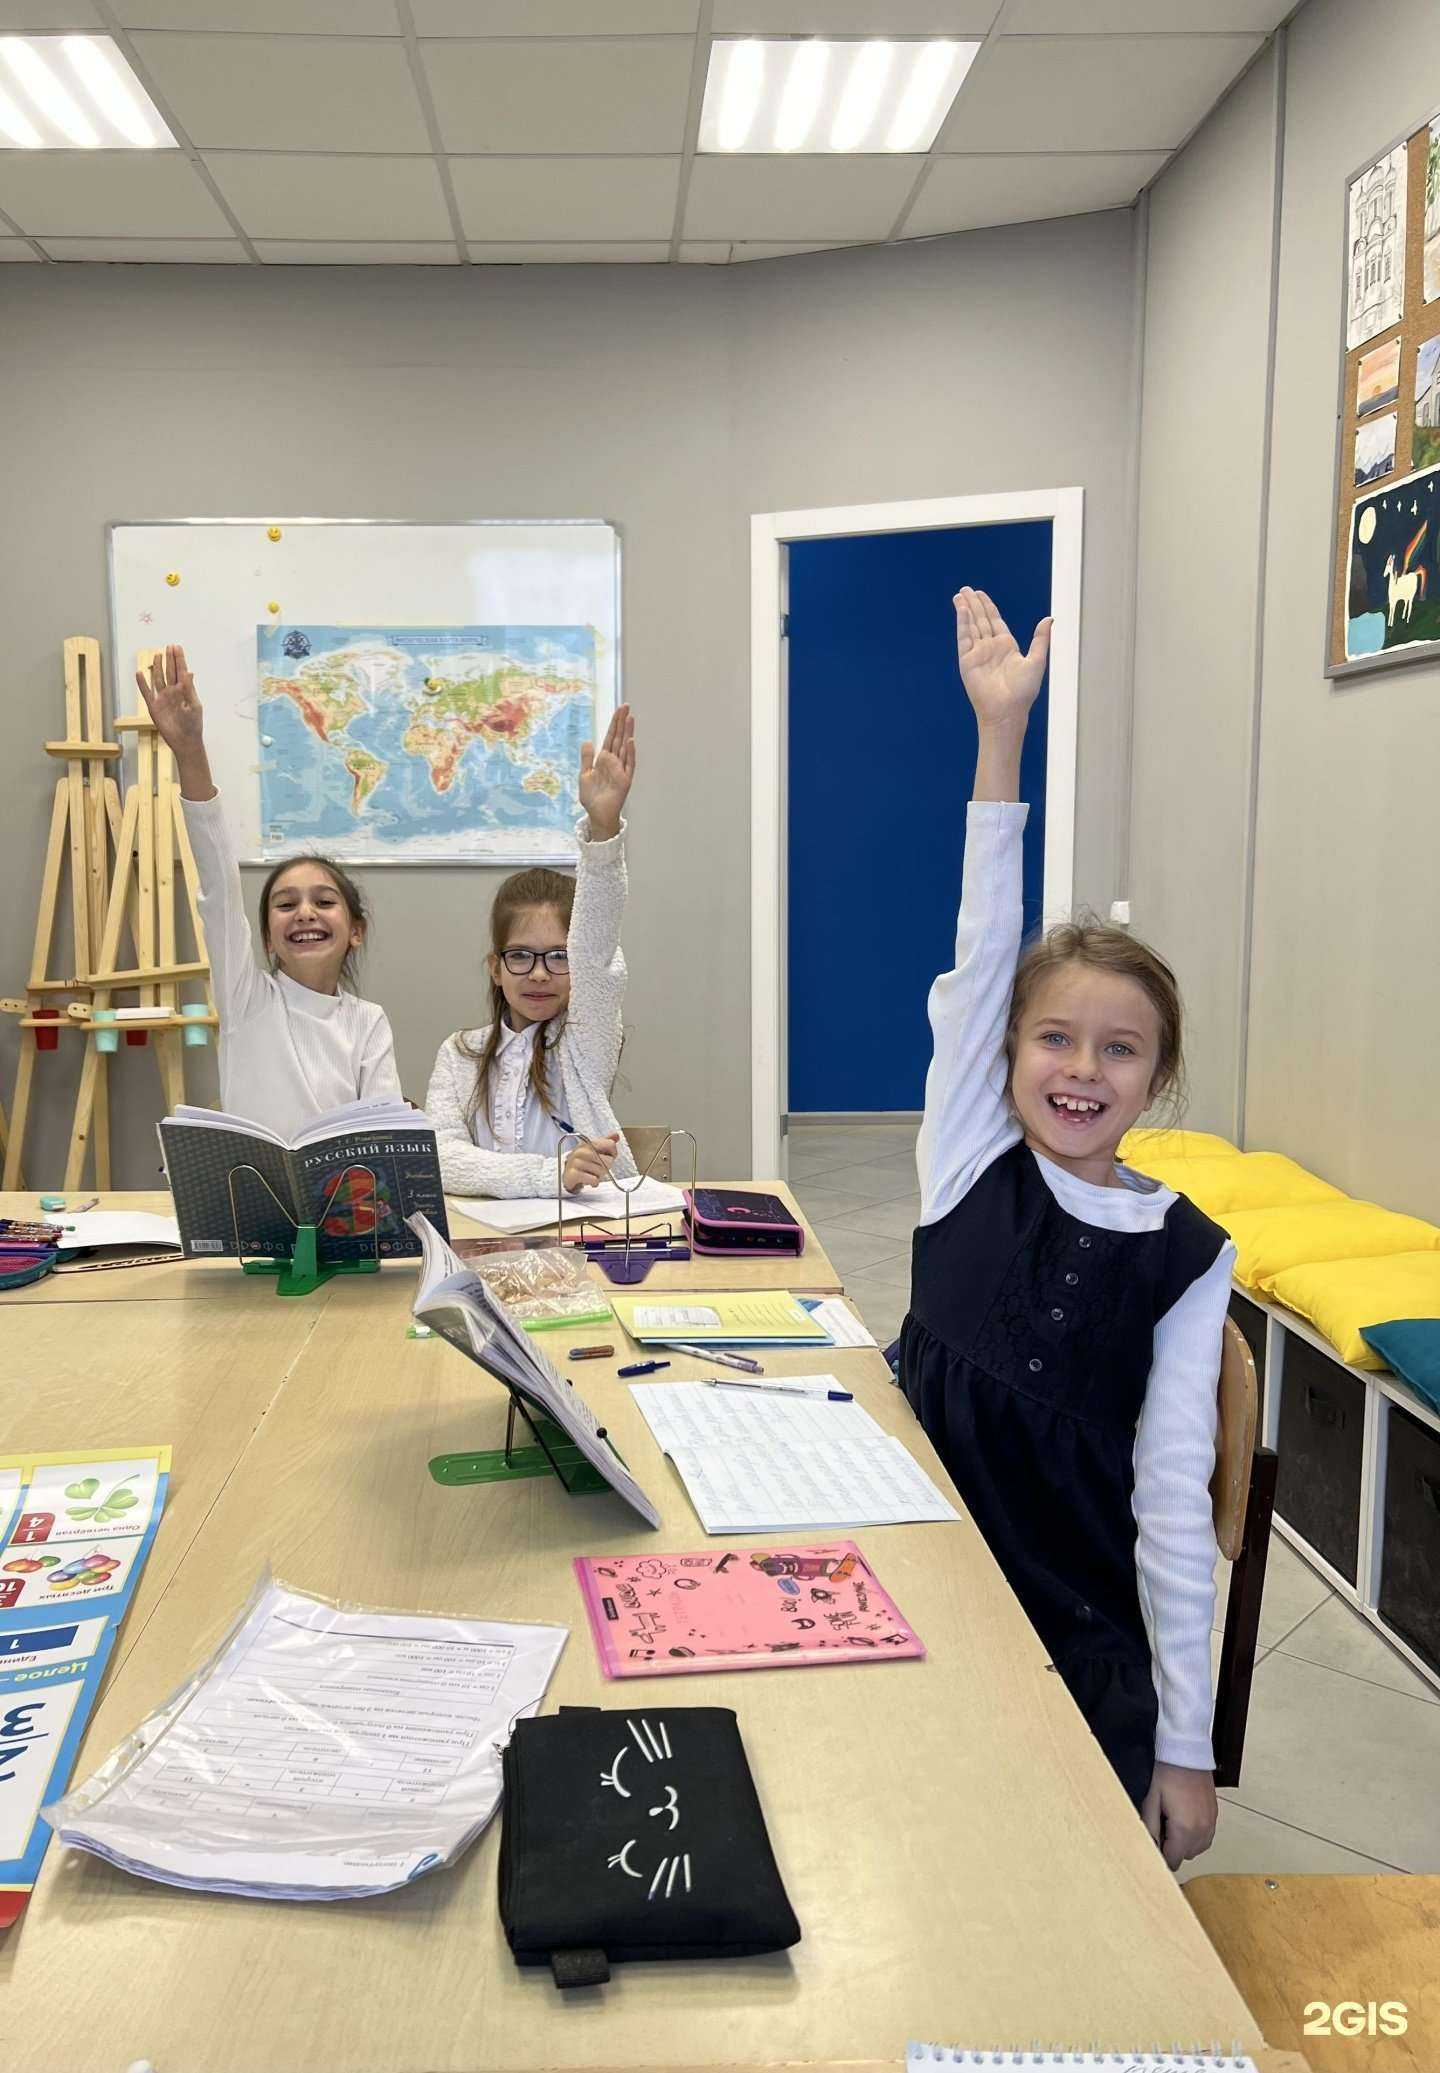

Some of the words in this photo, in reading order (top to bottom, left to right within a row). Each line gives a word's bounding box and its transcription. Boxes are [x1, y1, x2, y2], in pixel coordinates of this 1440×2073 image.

[304, 1143, 380, 1168] РУССКИЙ
[384, 1143, 433, 1153] ЯЗЫК
[28, 1516, 45, 1528] 4
[24, 1531, 37, 1542] 1
[10, 1639, 20, 1650] 1
[14, 1661, 88, 1683] Целое
[0, 1703, 46, 1736] 3
